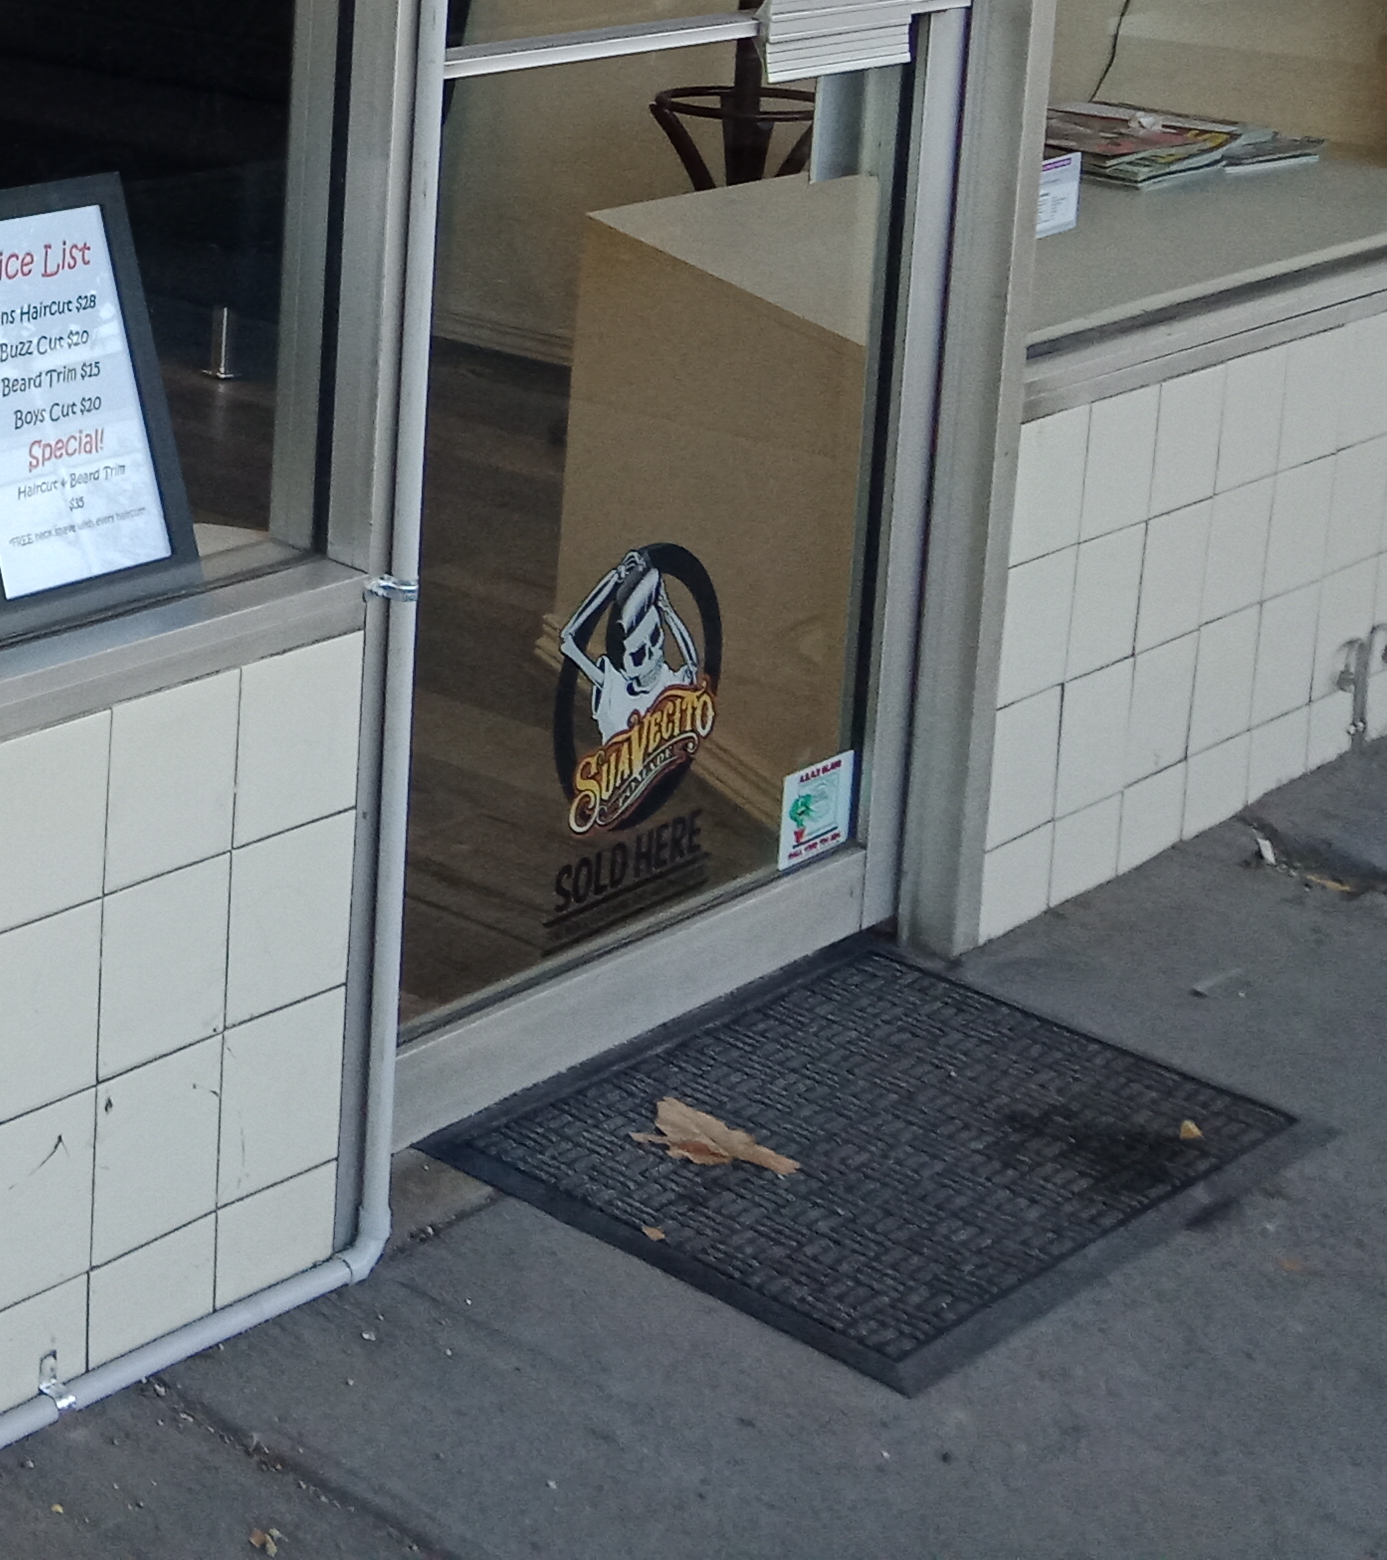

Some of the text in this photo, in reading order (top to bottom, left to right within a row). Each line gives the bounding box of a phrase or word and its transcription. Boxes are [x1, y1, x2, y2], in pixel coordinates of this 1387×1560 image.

[41, 240, 91, 278] List
[75, 293, 97, 313] $28
[36, 335, 64, 355] Cut
[67, 329, 89, 350] $20
[1, 361, 101, 398] Beard Trim $15
[13, 396, 102, 430] Boys Cut $20
[28, 427, 105, 473] Special!
[69, 469, 100, 489] Beard
[569, 680, 715, 833] SUAVECITO
[553, 808, 704, 913] SOLD HERE
